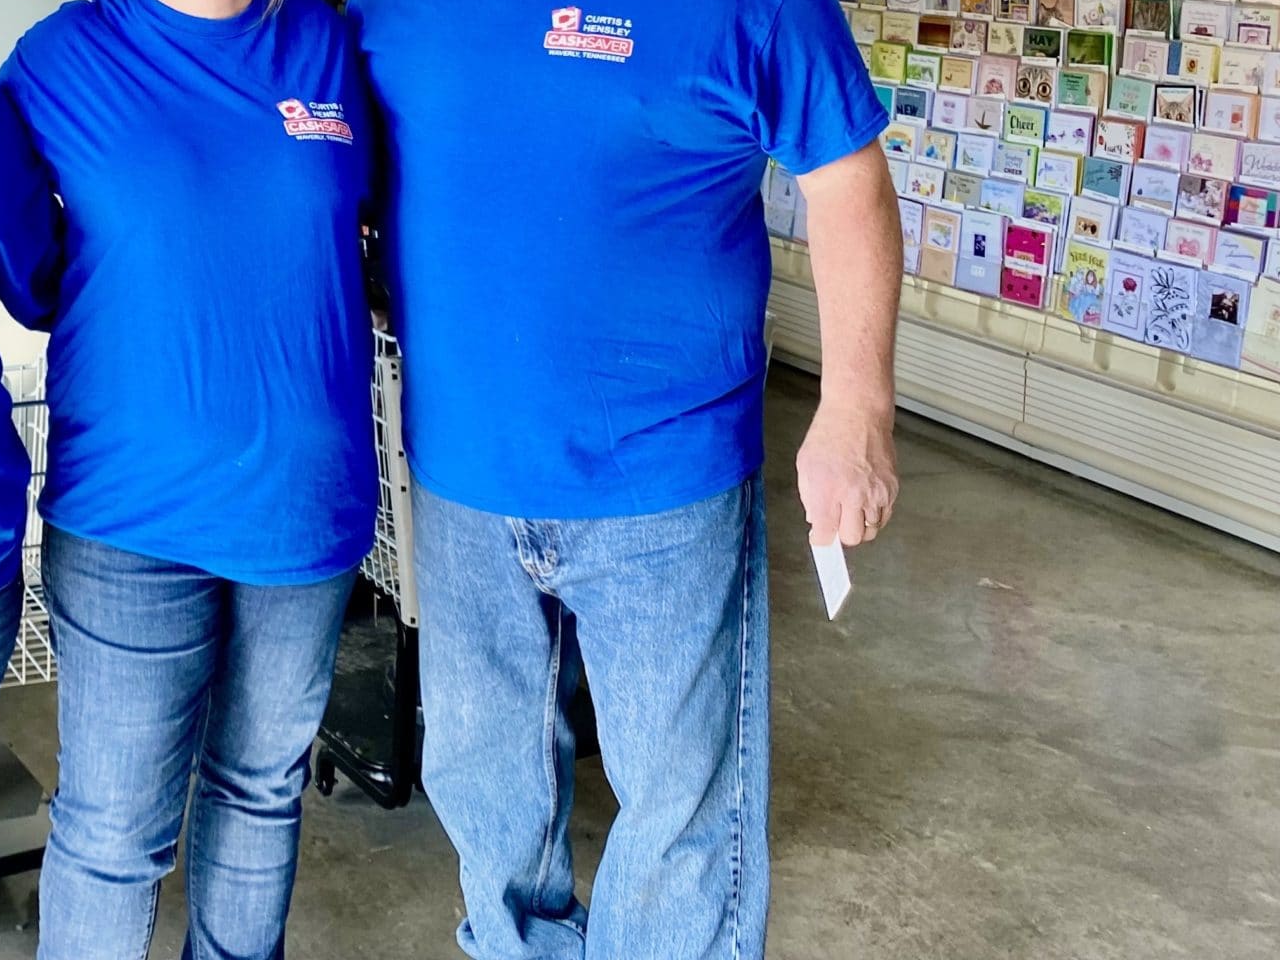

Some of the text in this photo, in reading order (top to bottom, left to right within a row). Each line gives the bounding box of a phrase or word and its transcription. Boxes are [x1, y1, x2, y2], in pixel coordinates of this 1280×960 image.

[585, 14, 633, 28] CURTIS &
[583, 24, 631, 37] HENSLEY
[547, 34, 629, 53] CASHSAVER
[1029, 34, 1053, 46] HAY
[1010, 115, 1035, 131] Cheer
